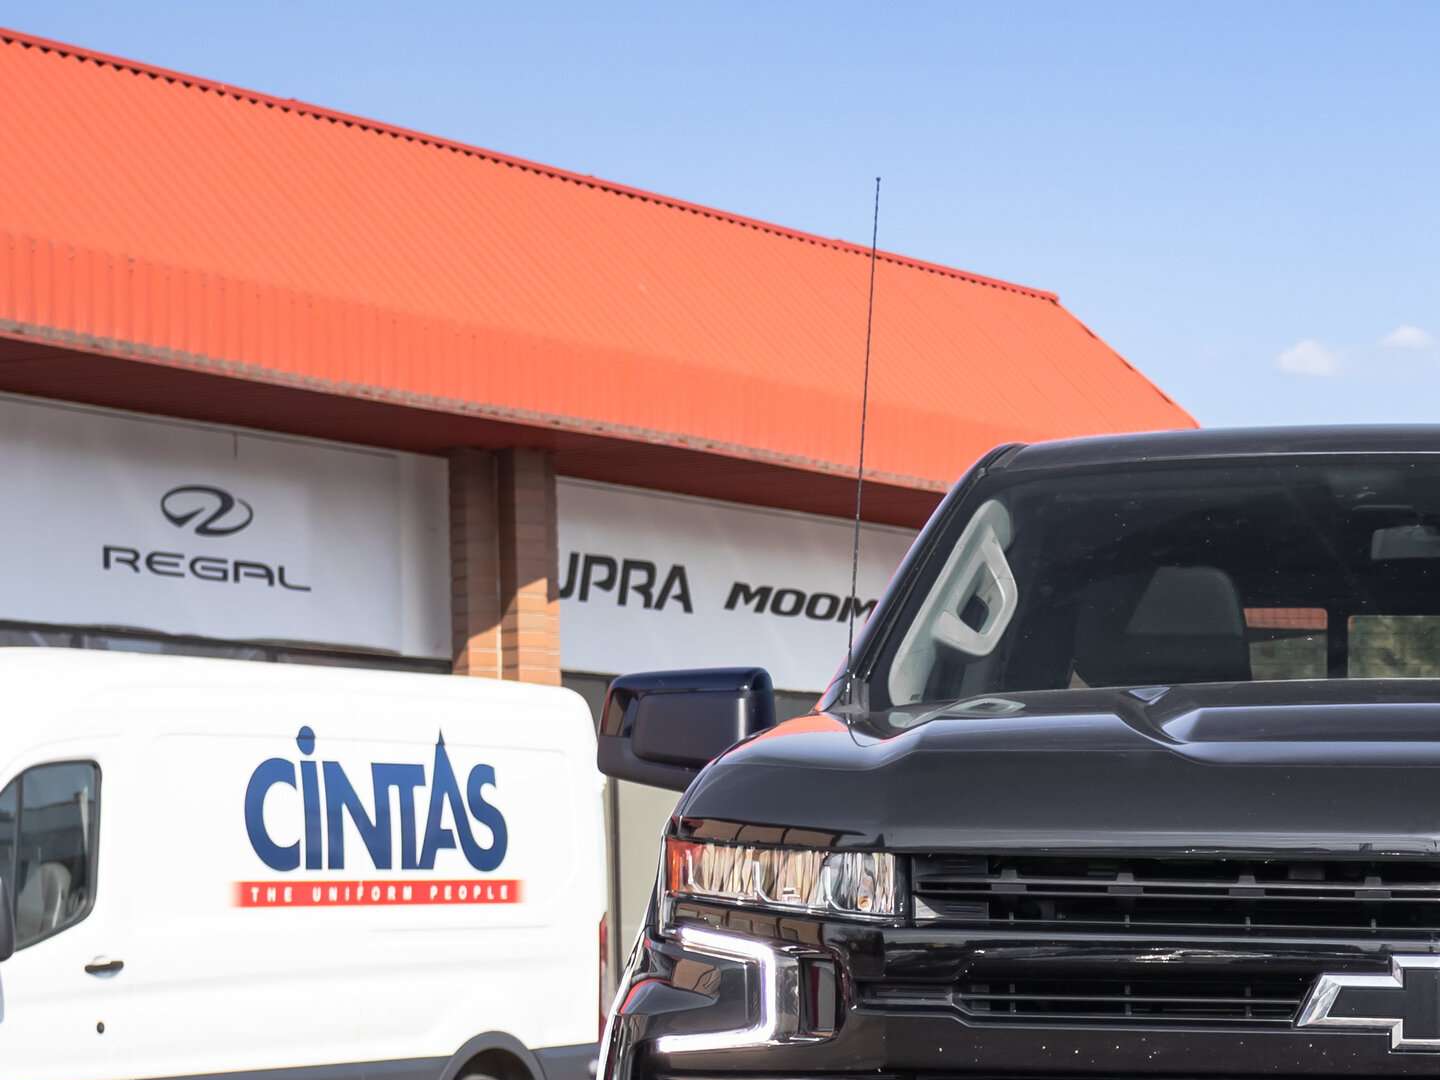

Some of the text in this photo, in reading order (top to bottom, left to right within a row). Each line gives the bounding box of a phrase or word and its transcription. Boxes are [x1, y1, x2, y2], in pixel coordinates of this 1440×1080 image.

[103, 545, 312, 592] REGAL
[244, 726, 508, 872] CINTAS
[251, 885, 508, 902] THE UNIFORM PEOPLE
